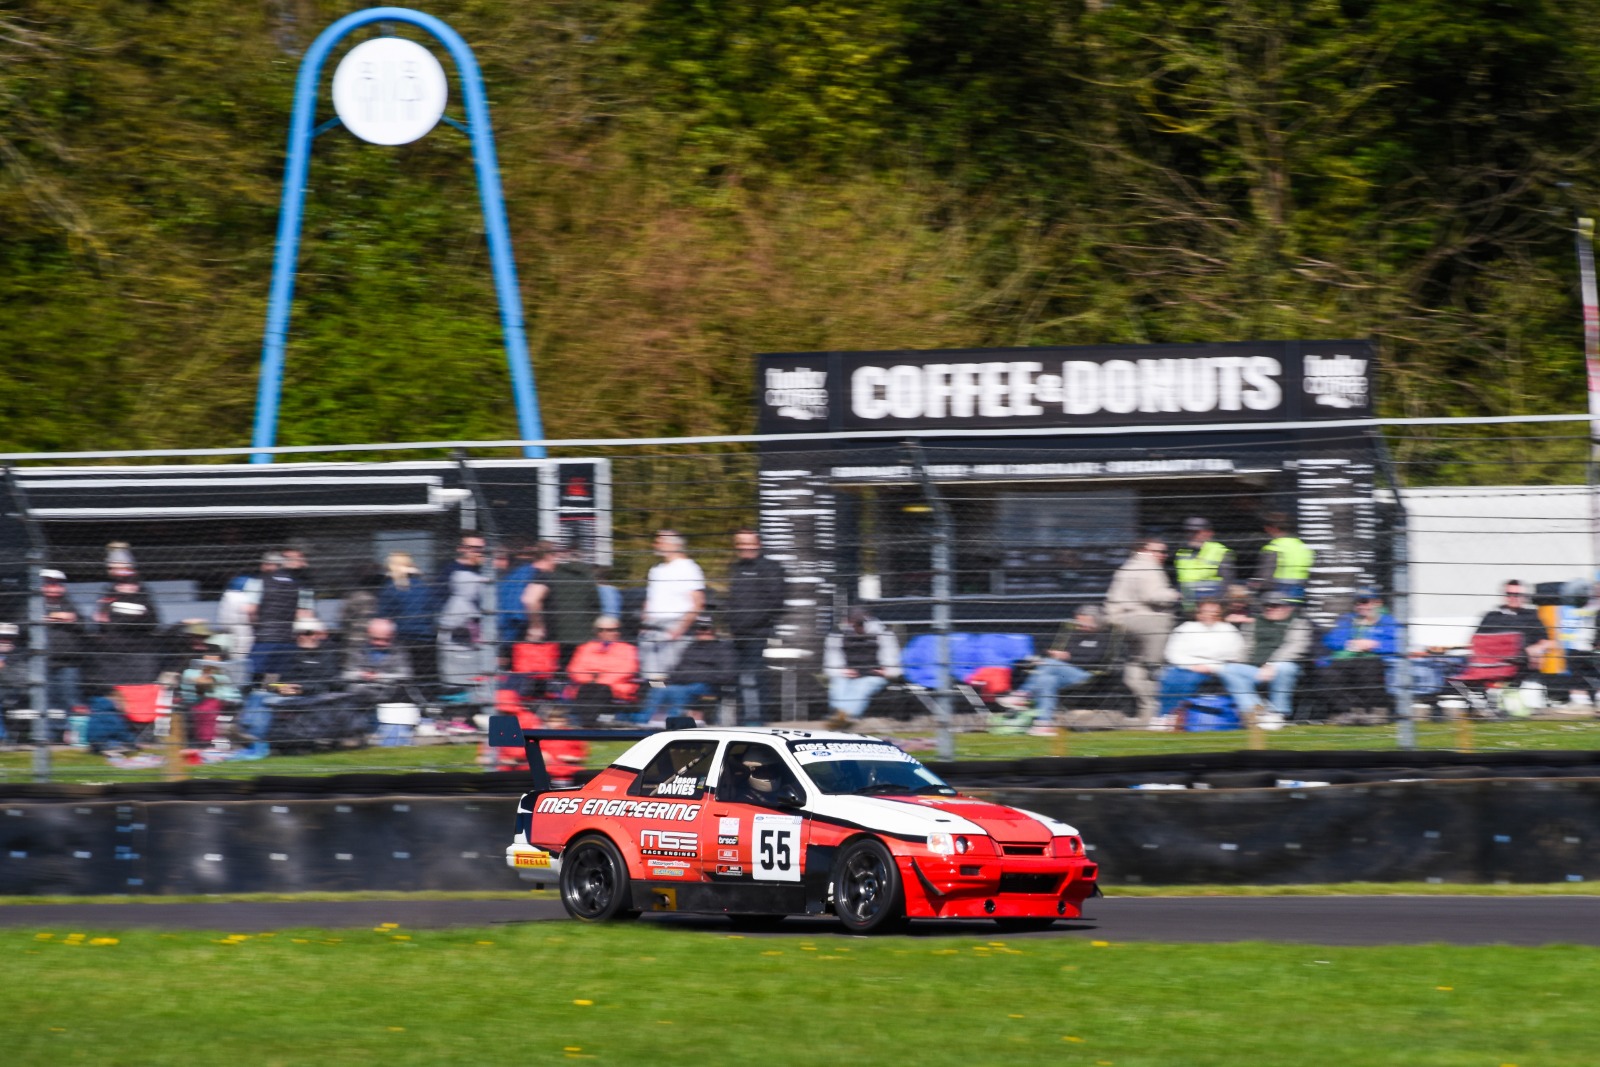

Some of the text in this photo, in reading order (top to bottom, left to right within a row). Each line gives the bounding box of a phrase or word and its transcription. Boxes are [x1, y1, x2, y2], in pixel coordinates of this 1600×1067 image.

[851, 361, 1043, 419] COFFEE
[1062, 356, 1282, 414] DONUTS
[658, 783, 695, 796] DAVIES
[673, 776, 697, 785] Jason
[581, 799, 701, 821] ENGINEERING
[641, 830, 698, 851] MSE
[760, 830, 791, 871] 55
[516, 854, 547, 866] PIRELLI
